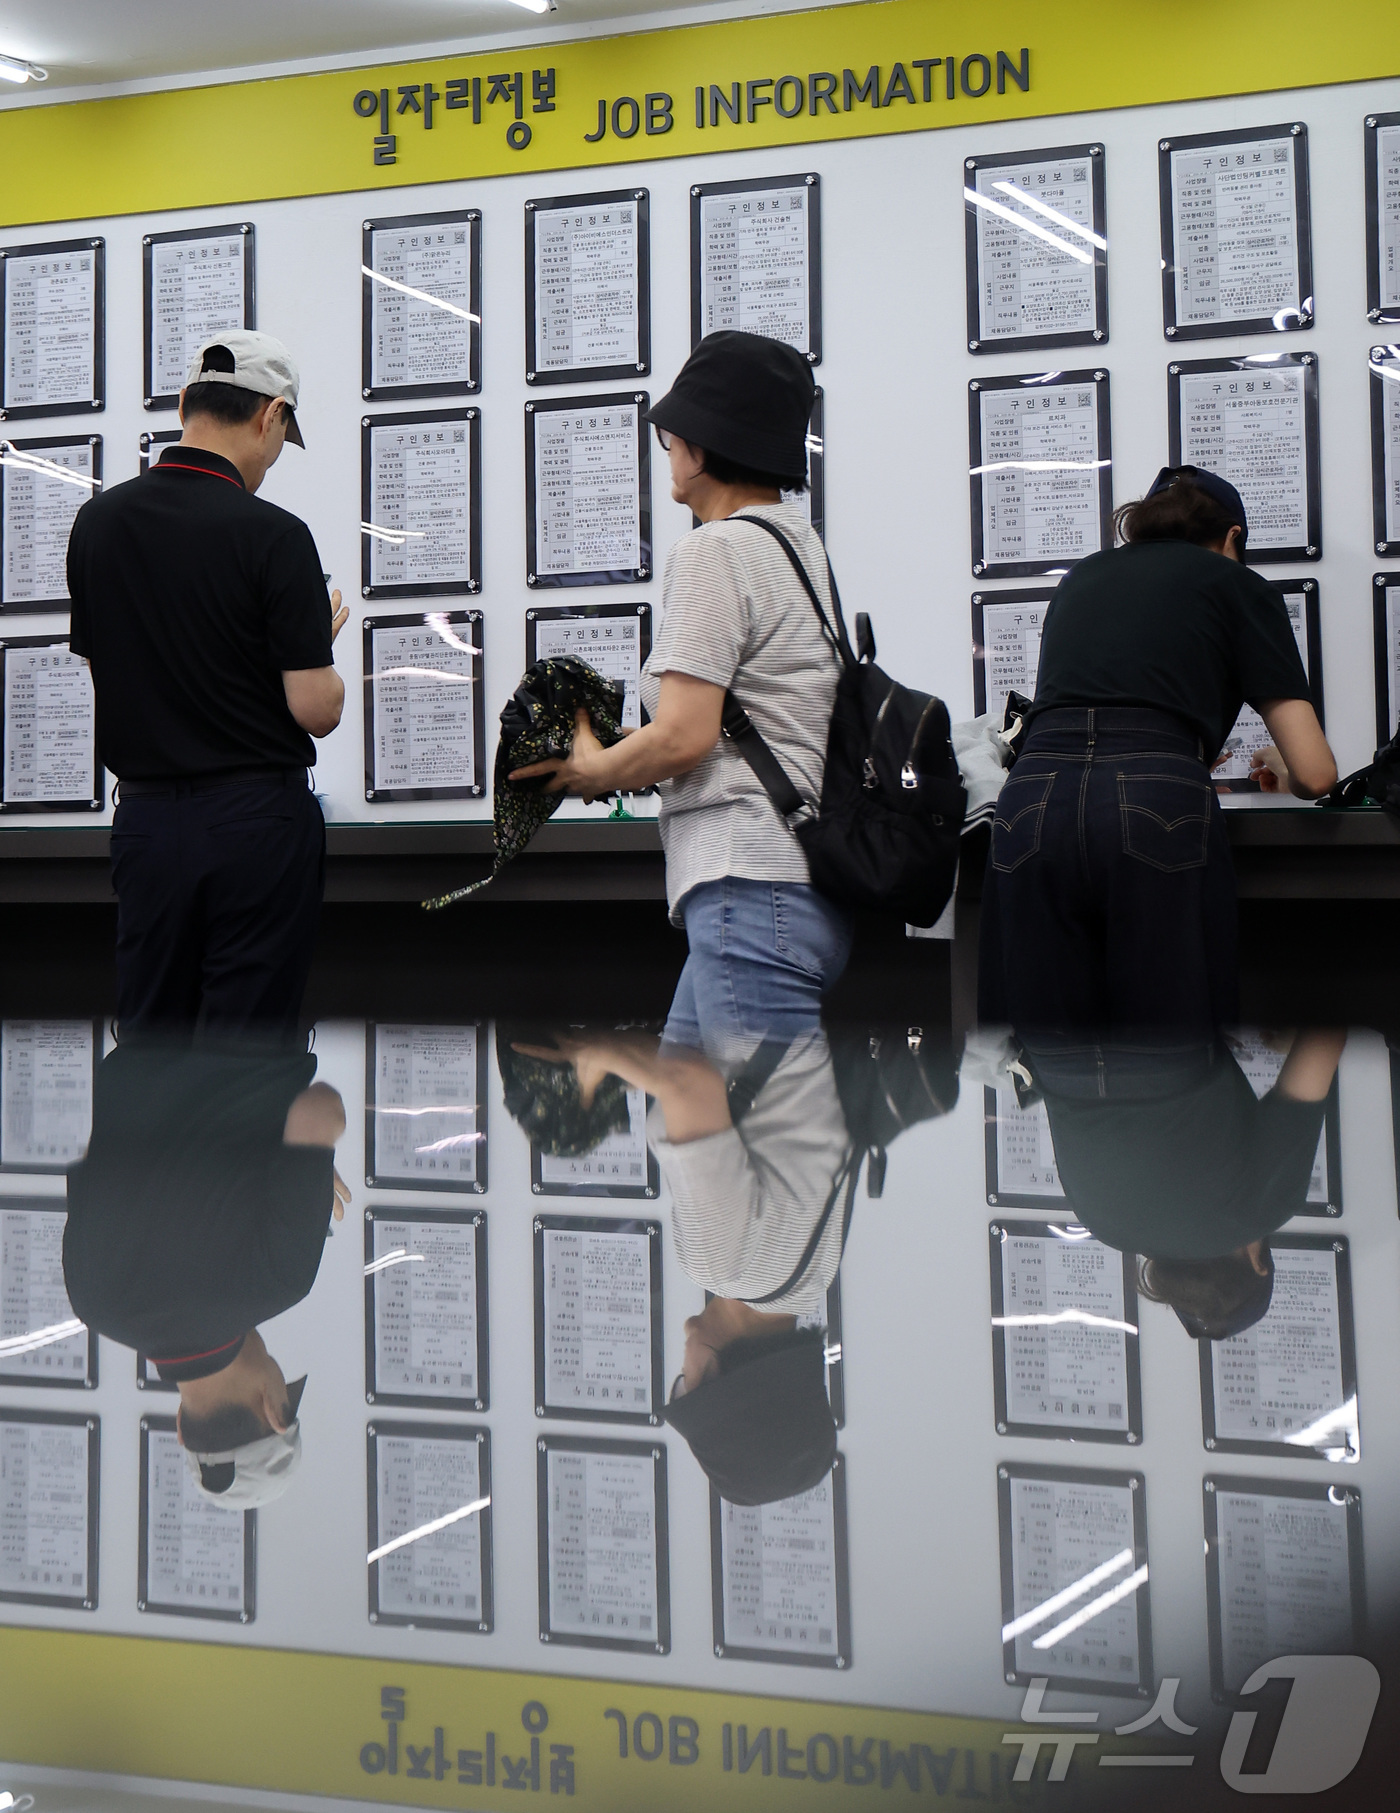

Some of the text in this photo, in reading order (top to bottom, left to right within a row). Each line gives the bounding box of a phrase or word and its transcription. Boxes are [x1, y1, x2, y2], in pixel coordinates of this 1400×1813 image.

[584, 47, 1030, 143] JOB INFORMATION
[353, 67, 556, 166] 일자리정보
[1202, 152, 1261, 169] 구인정보
[1217, 167, 1286, 182] 사단법인팅커벨프로젝트
[728, 199, 780, 214] 구인정보
[561, 214, 611, 228] 구인정보
[397, 234, 445, 247] 구인정보
[176, 246, 220, 259] 구인정보
[29, 262, 72, 274] 구인정보
[1212, 380, 1272, 394] 구인정보
[1010, 396, 1066, 409] 구인정보
[1225, 396, 1298, 408] 서울중부아동보호전문기관
[561, 417, 611, 430] 구인정보
[396, 432, 444, 444] 구인정보
[1013, 613, 1039, 625] 구인
[563, 628, 613, 640] 구인정보
[28, 656, 70, 666] 구인정보
